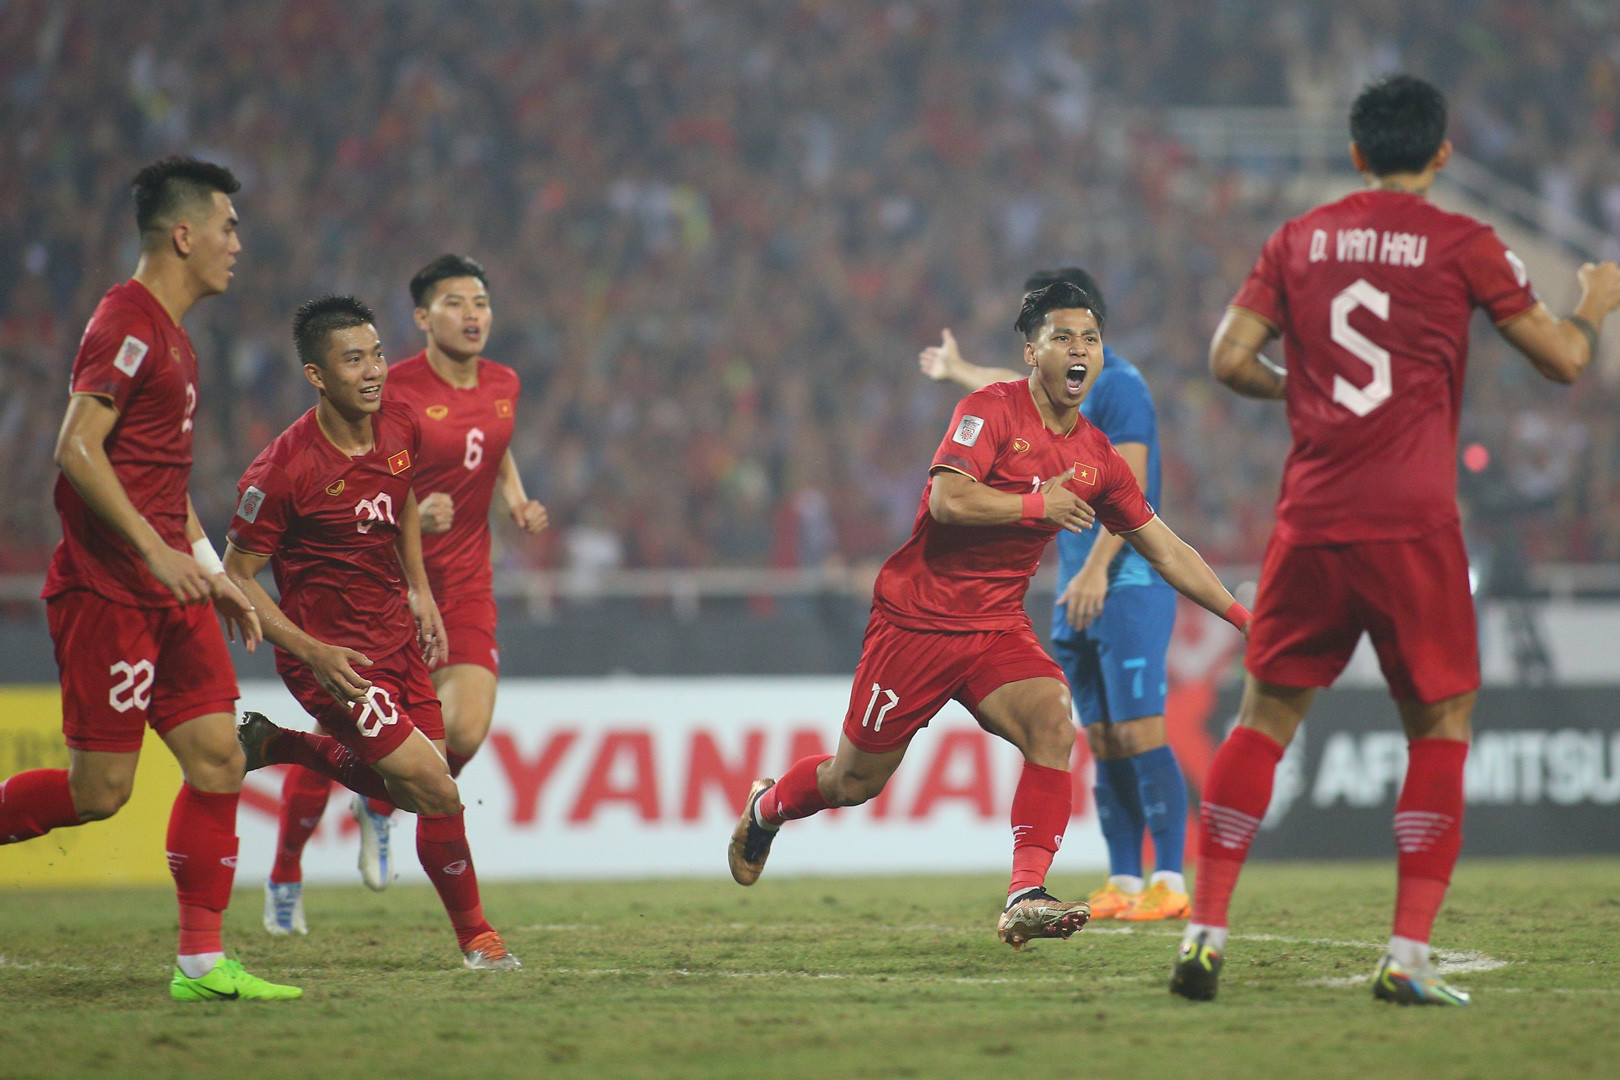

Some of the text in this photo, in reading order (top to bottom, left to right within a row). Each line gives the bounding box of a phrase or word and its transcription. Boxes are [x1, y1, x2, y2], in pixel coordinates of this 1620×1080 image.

[1336, 227, 1378, 263] VAN
[1380, 230, 1428, 267] HAU
[1330, 278, 1392, 417] 5
[463, 427, 484, 470] 6
[109, 659, 155, 713] 22
[1122, 657, 1147, 699] 7
[348, 685, 399, 737] 20
[861, 682, 900, 732] 17
